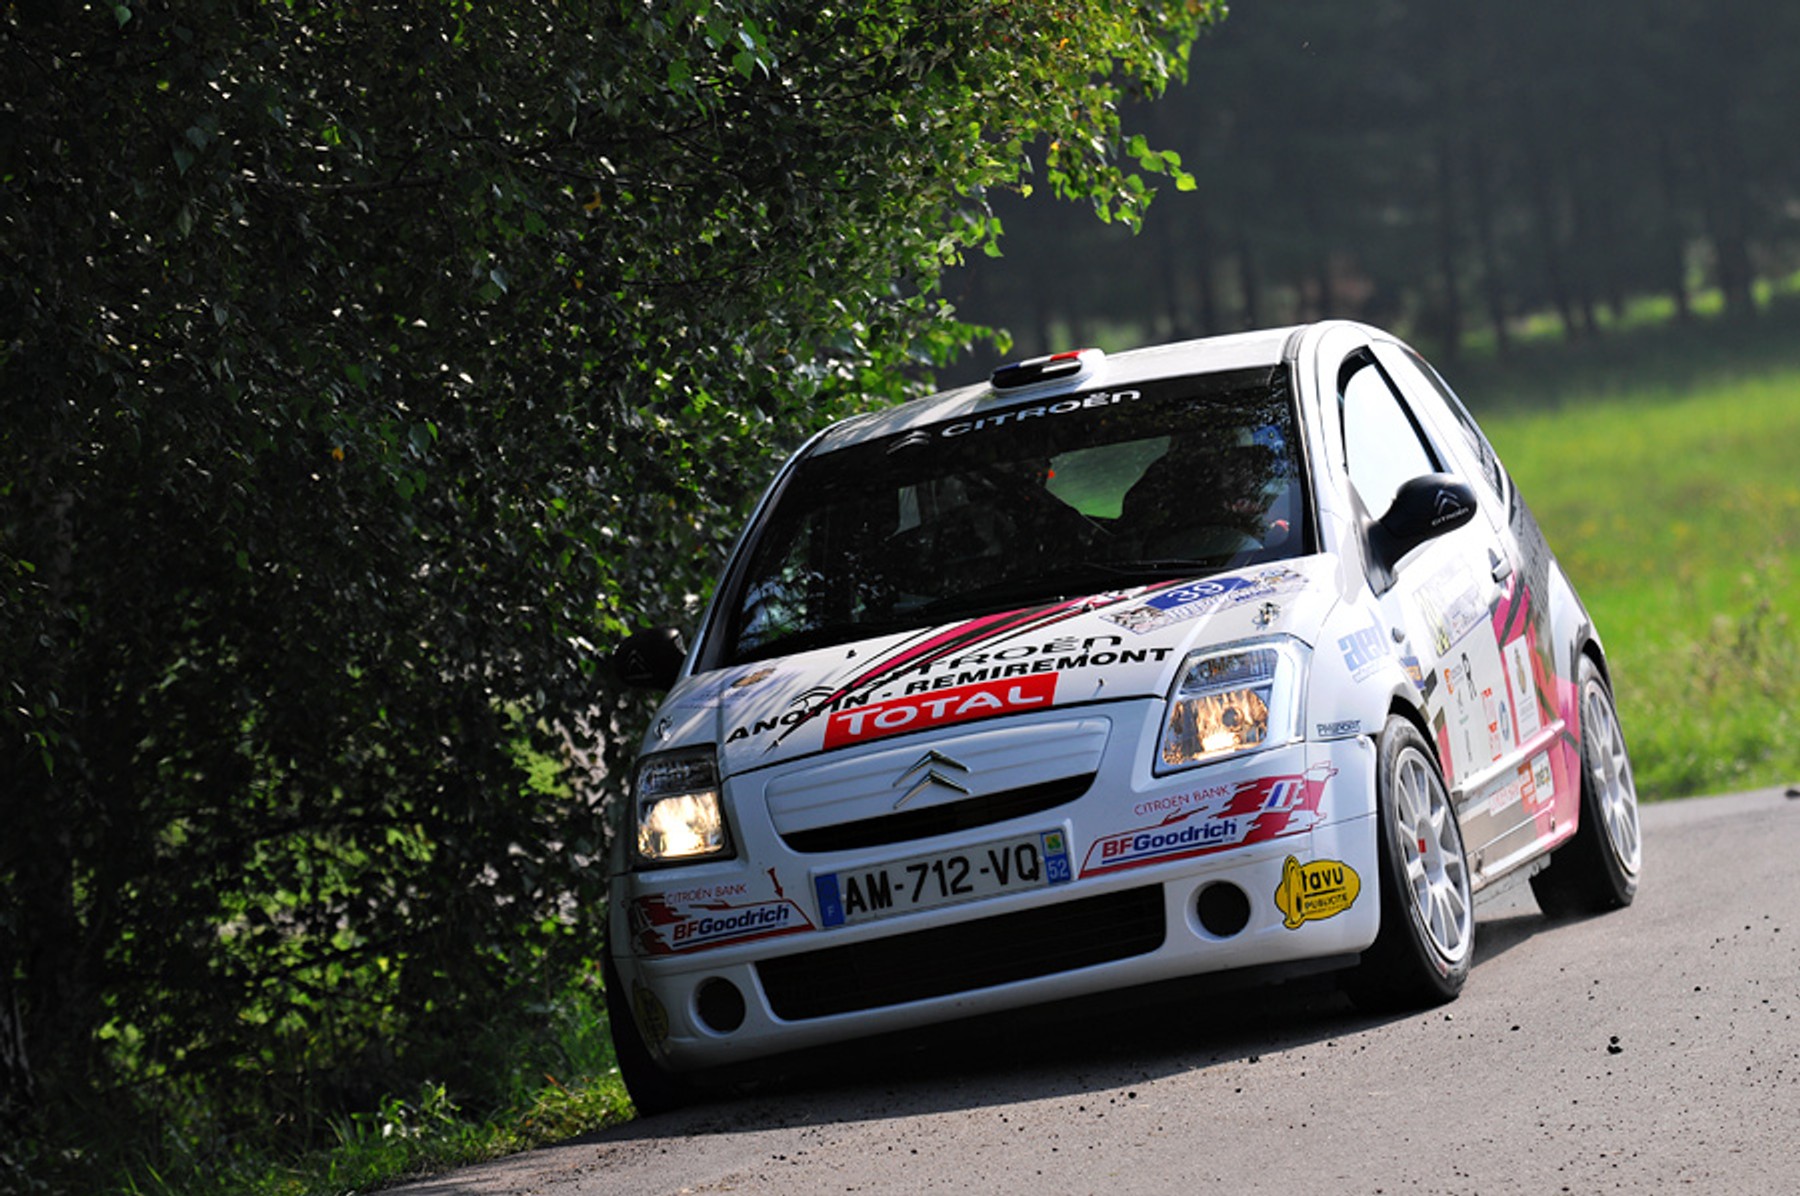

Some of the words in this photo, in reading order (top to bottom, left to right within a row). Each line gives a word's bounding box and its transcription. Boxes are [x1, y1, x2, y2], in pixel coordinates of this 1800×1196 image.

[941, 389, 1141, 437] CITROËN
[905, 648, 1174, 694] REMIREMONT
[836, 686, 1044, 736] TOTAL
[1193, 784, 1231, 802] BANK
[1101, 820, 1238, 858] BFGoodrich
[1048, 859, 1068, 881] 52
[714, 884, 747, 899] BANK
[673, 904, 789, 941] BFGoodrich
